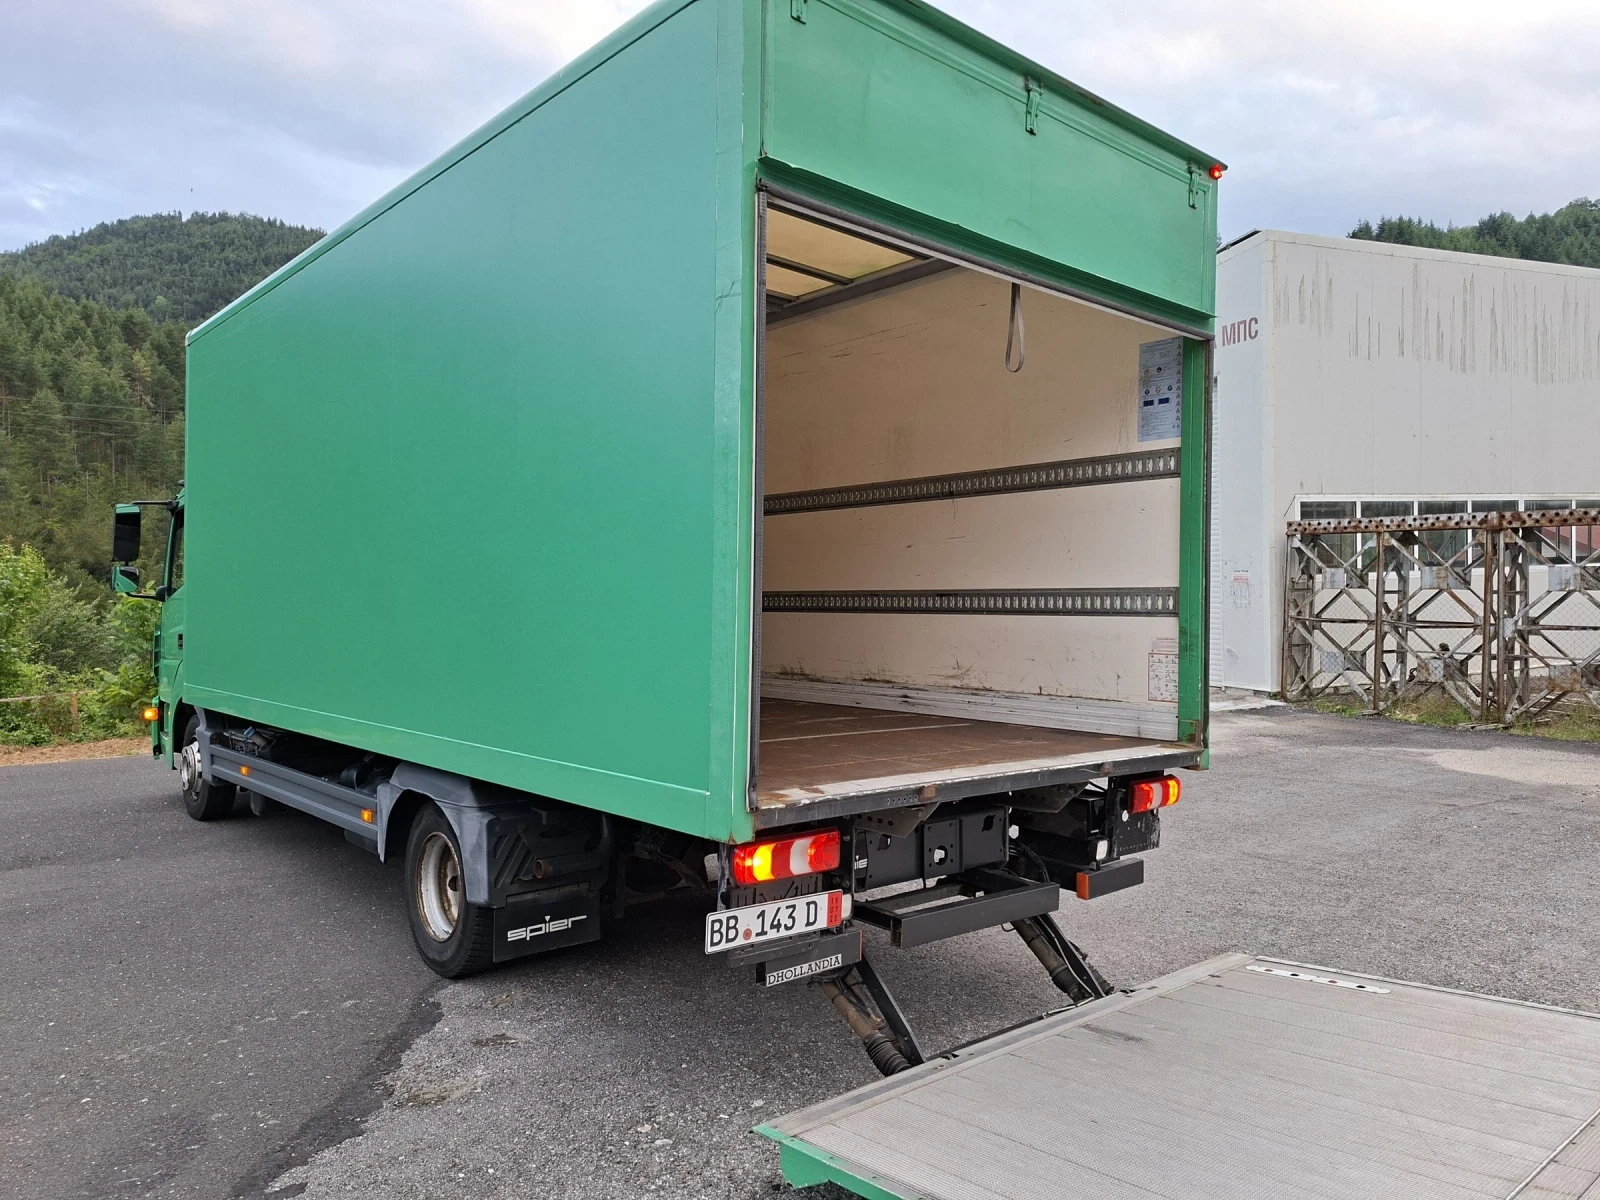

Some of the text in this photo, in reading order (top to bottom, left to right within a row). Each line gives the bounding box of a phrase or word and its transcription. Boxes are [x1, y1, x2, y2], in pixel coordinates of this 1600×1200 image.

[1222, 316, 1259, 347] МПС
[709, 900, 818, 948] BB 143 D
[829, 905, 839, 914] 07
[507, 915, 588, 942] spier
[767, 955, 841, 986] DHOLLANDIA
